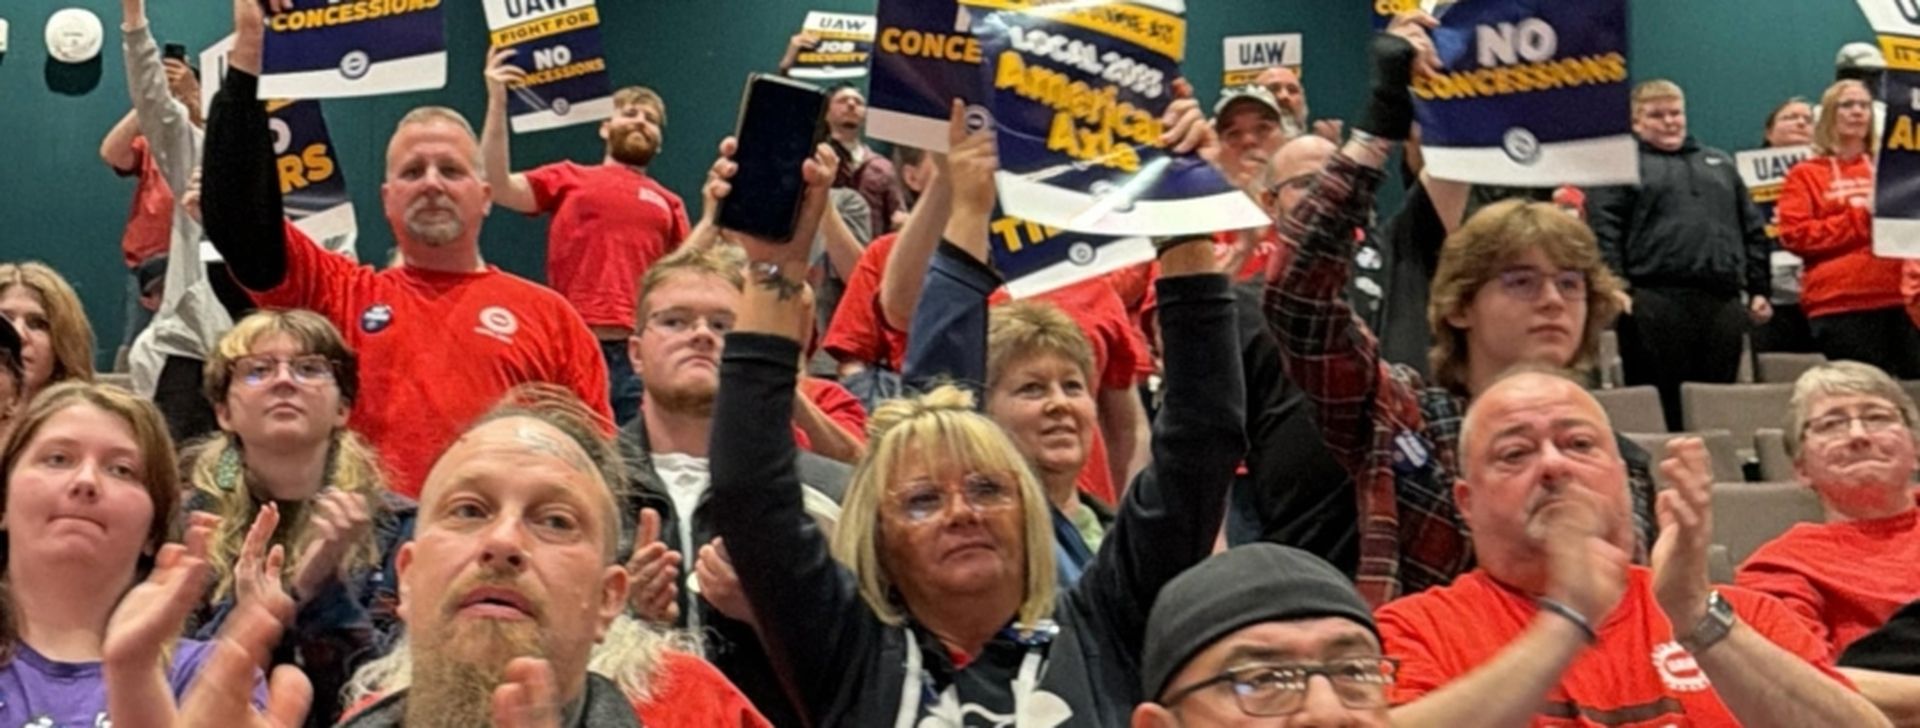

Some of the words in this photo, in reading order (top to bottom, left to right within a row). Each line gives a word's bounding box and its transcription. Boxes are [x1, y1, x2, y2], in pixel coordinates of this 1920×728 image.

[500, 21, 550, 43] FIGHT
[556, 11, 591, 30] FOR
[819, 17, 866, 30] UAW
[533, 45, 571, 71] NO
[880, 27, 982, 64] CONCE
[1239, 41, 1286, 65] UAW
[1476, 17, 1558, 67] NO
[1410, 52, 1627, 99] CONCESSIONS
[277, 143, 334, 193] RS
